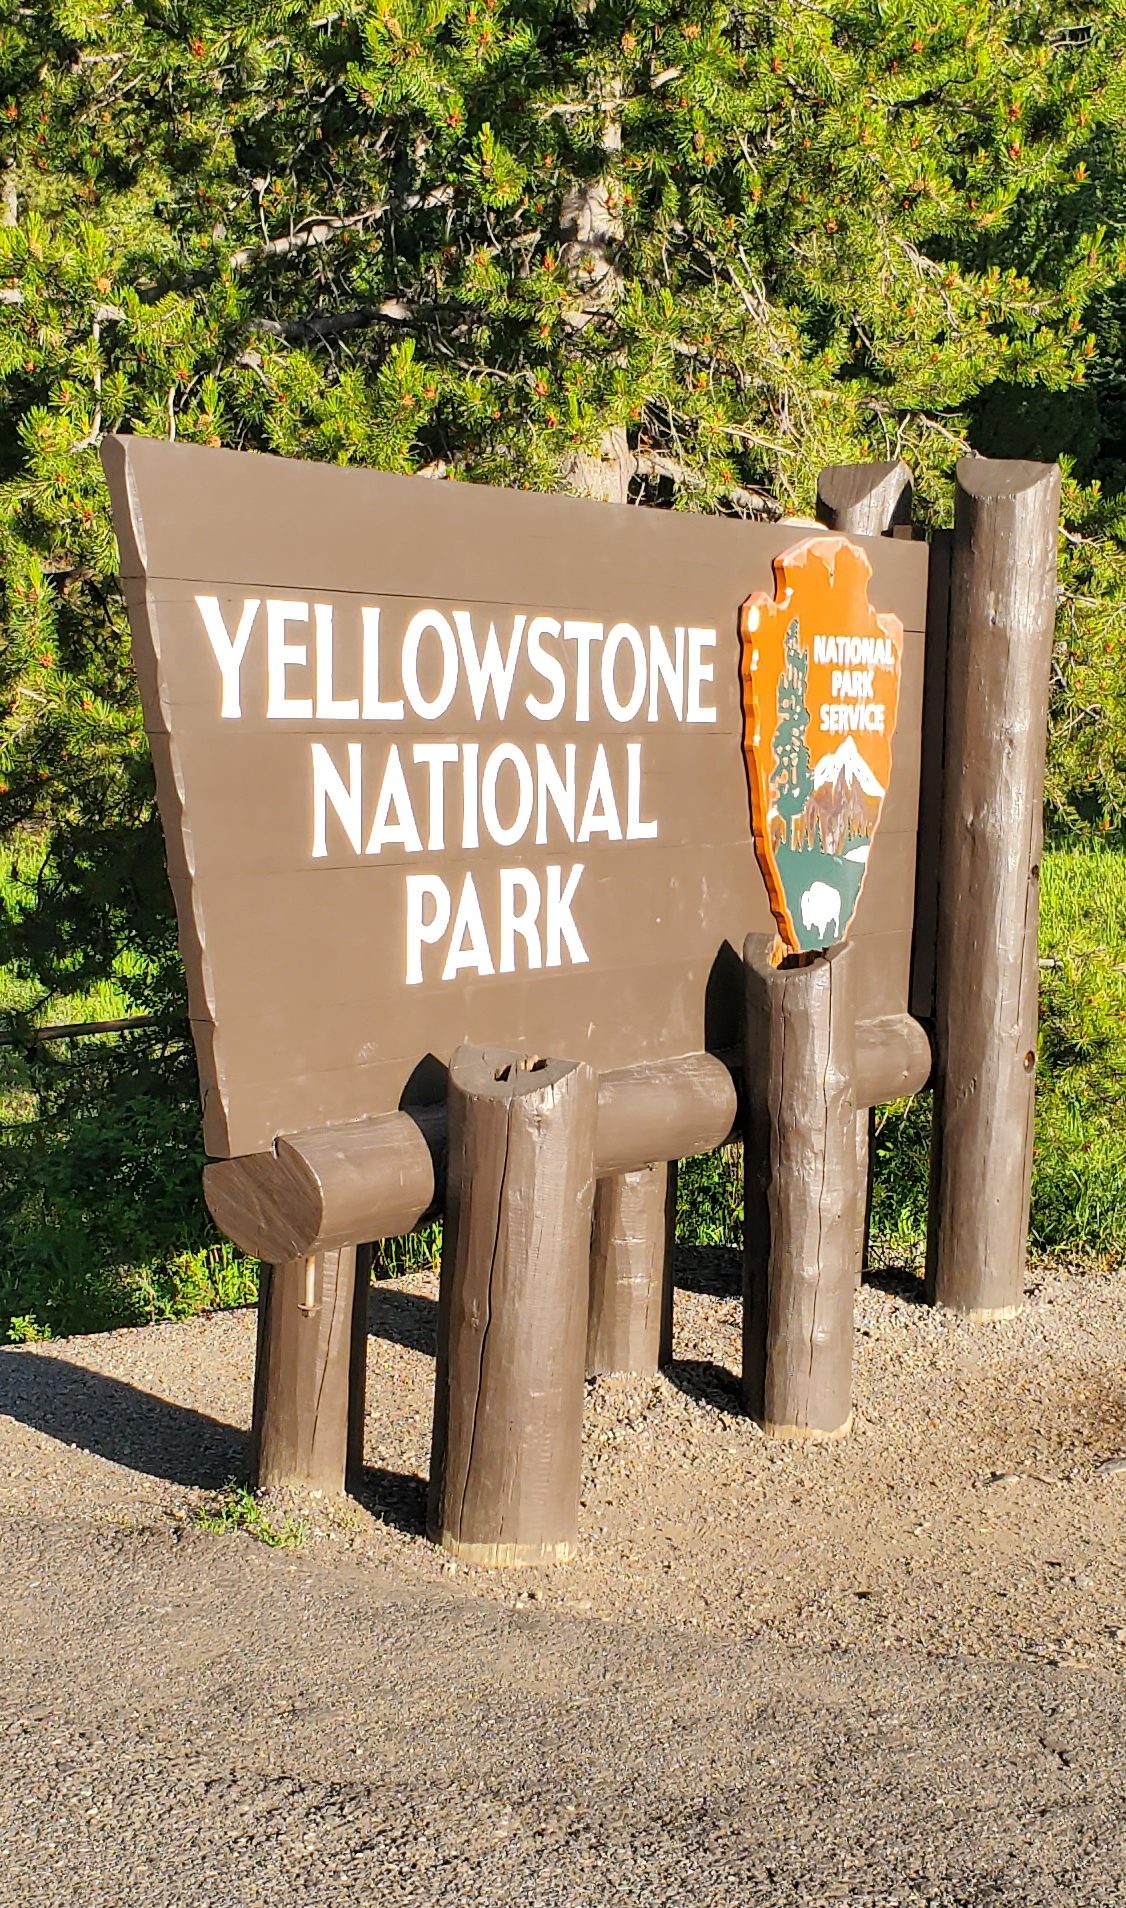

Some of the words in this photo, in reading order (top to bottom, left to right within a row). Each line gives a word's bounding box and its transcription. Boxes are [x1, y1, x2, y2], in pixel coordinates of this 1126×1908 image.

[194, 595, 718, 723] YELLOWSTONE
[814, 635, 895, 665] NATIONAL
[832, 670, 874, 698] PARK
[820, 704, 886, 732] SERVICE
[310, 742, 658, 859] NATIONAL
[404, 863, 590, 986] PARK
